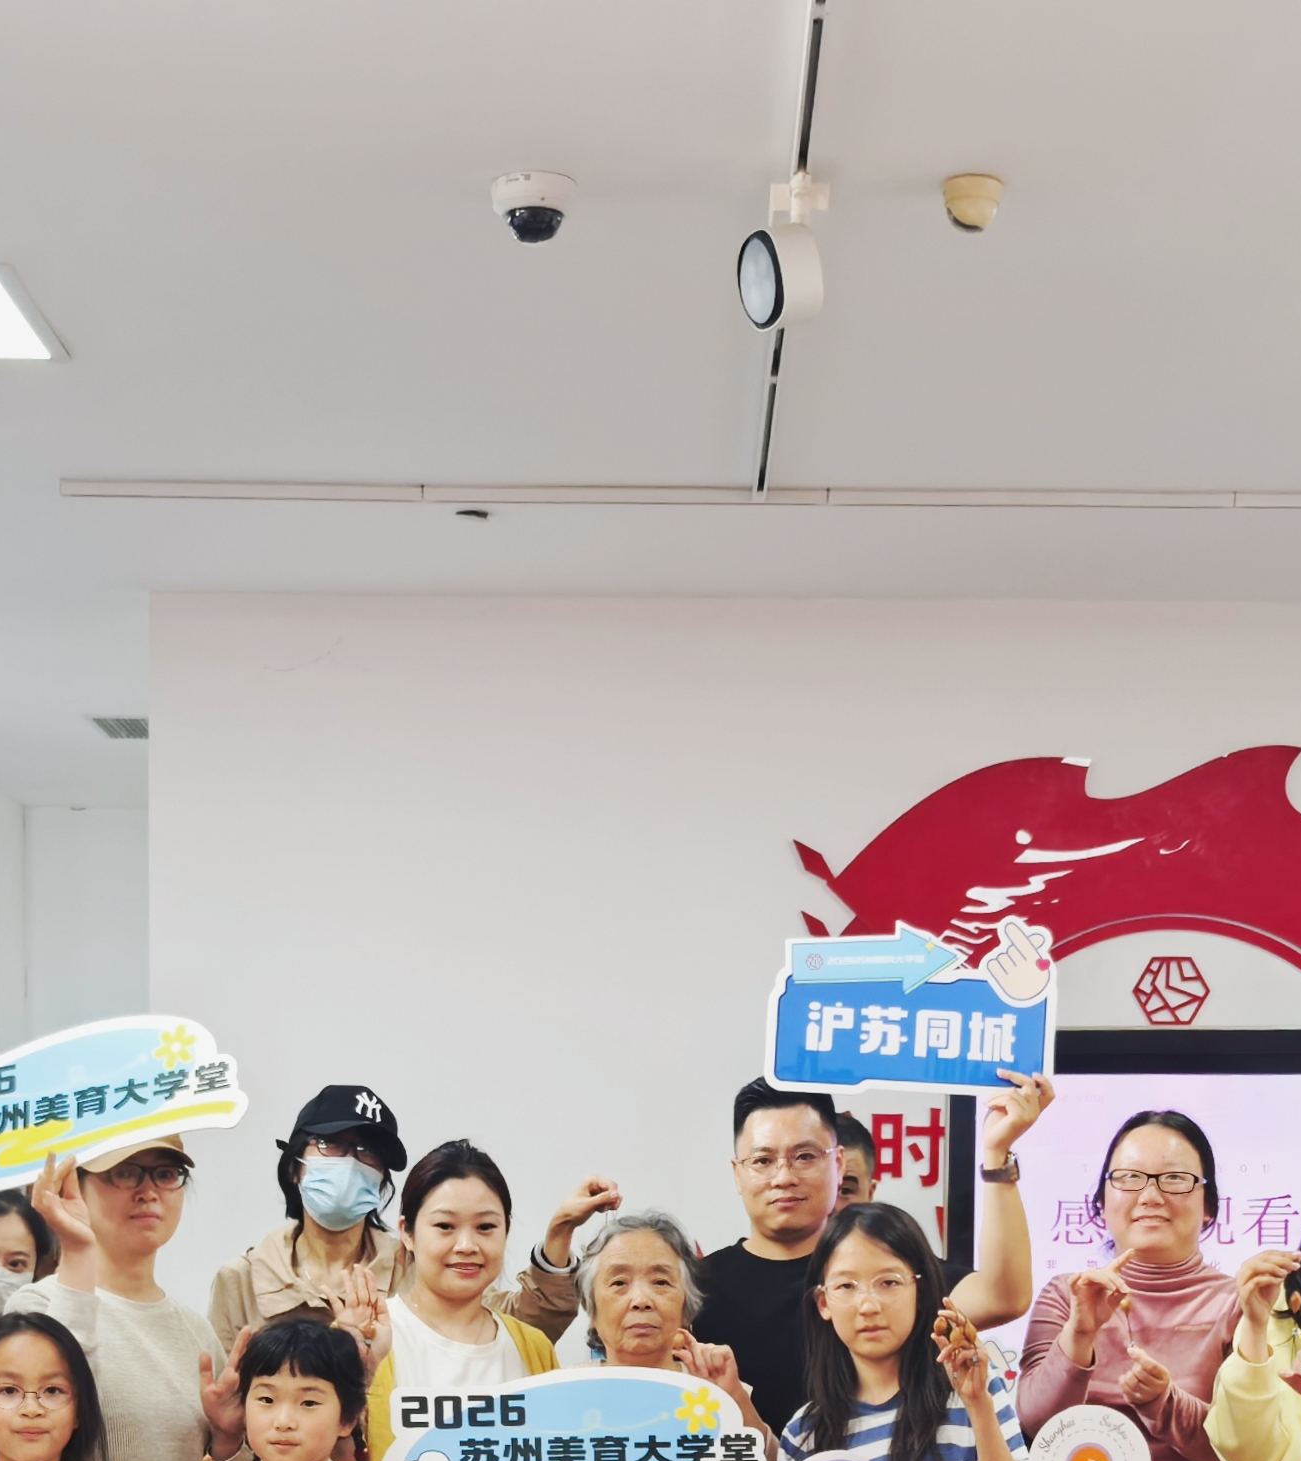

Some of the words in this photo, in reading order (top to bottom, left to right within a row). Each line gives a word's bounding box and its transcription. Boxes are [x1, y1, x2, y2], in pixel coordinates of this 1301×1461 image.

[805, 1001, 1017, 1063] 沪苏同城
[401, 1394, 526, 1429] 2026
[1037, 1416, 1076, 1453] Shanghai
